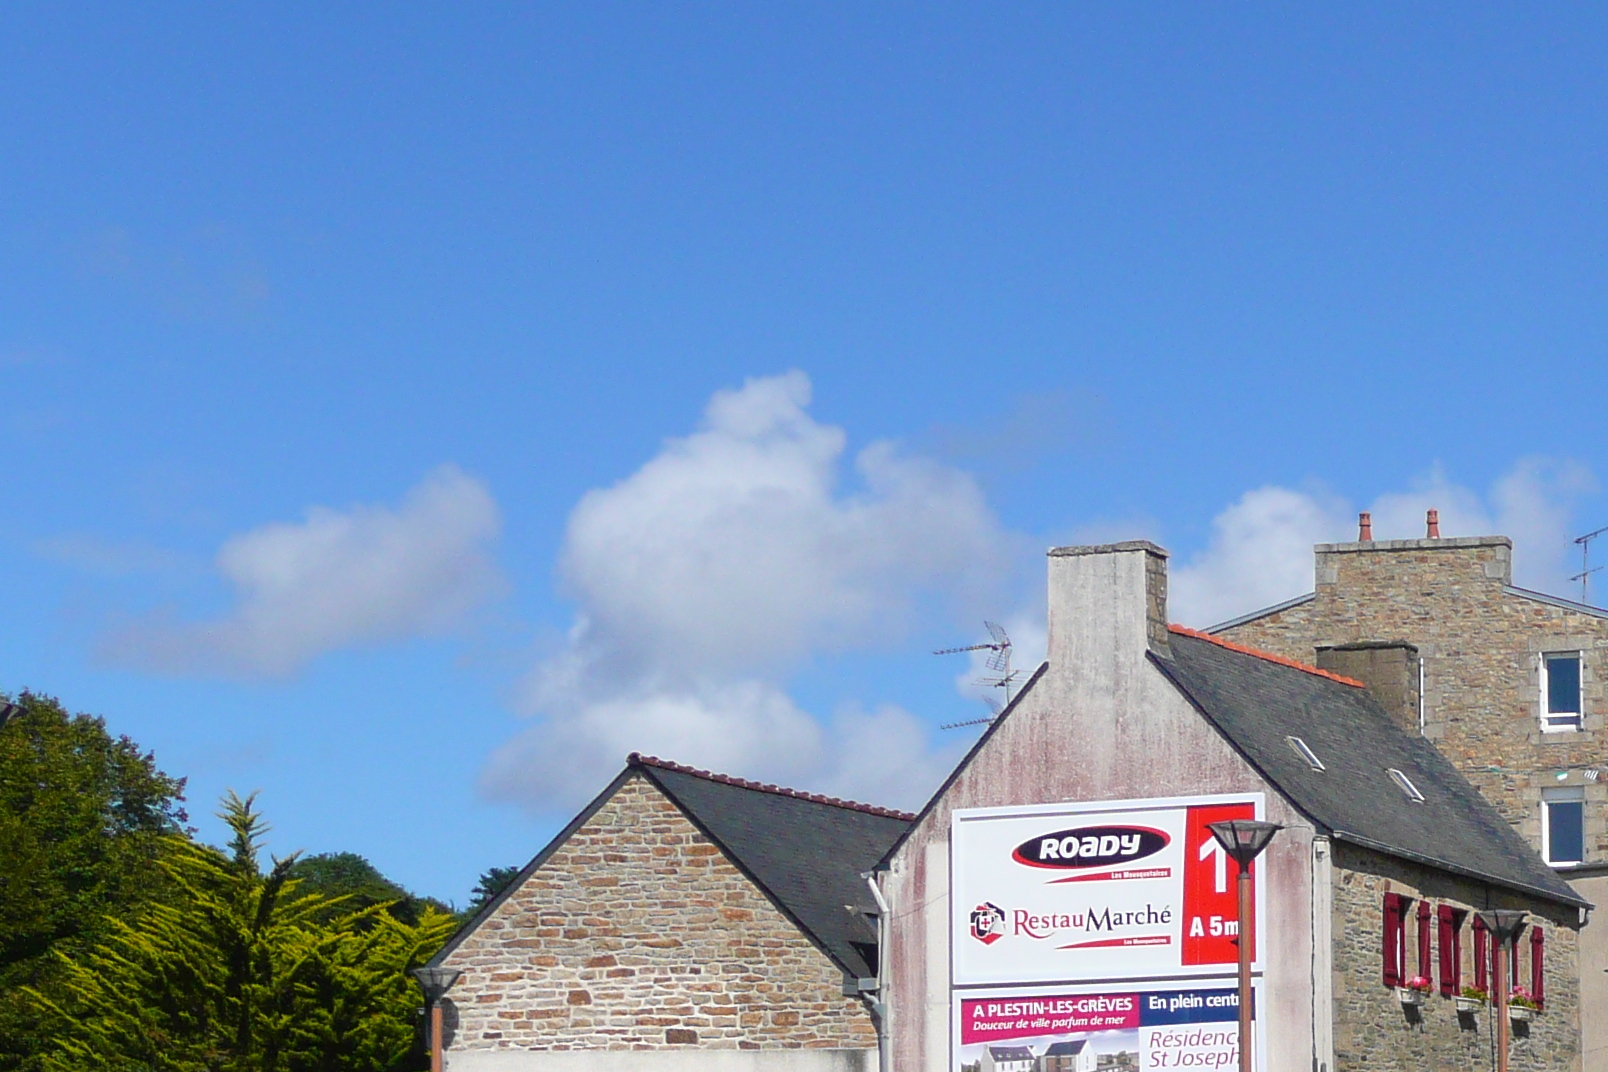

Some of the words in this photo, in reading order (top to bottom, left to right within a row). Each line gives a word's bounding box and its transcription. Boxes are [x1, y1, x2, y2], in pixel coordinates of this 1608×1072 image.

[1190, 916, 1204, 937] A
[973, 1005, 984, 1018] A
[988, 996, 1132, 1017] PLESTIN-LES-GRÈVES
[1149, 996, 1166, 1009] En
[1170, 993, 1203, 1012] plein
[973, 1020, 1014, 1031] Douceur
[1016, 1018, 1028, 1028] de
[1030, 1018, 1050, 1028] ville
[1052, 1016, 1088, 1030] parfum
[1090, 1016, 1102, 1025] de
[1105, 1016, 1126, 1025] mer
[1149, 1028, 1239, 1048] Résidenc
[1149, 1051, 1168, 1068] St
